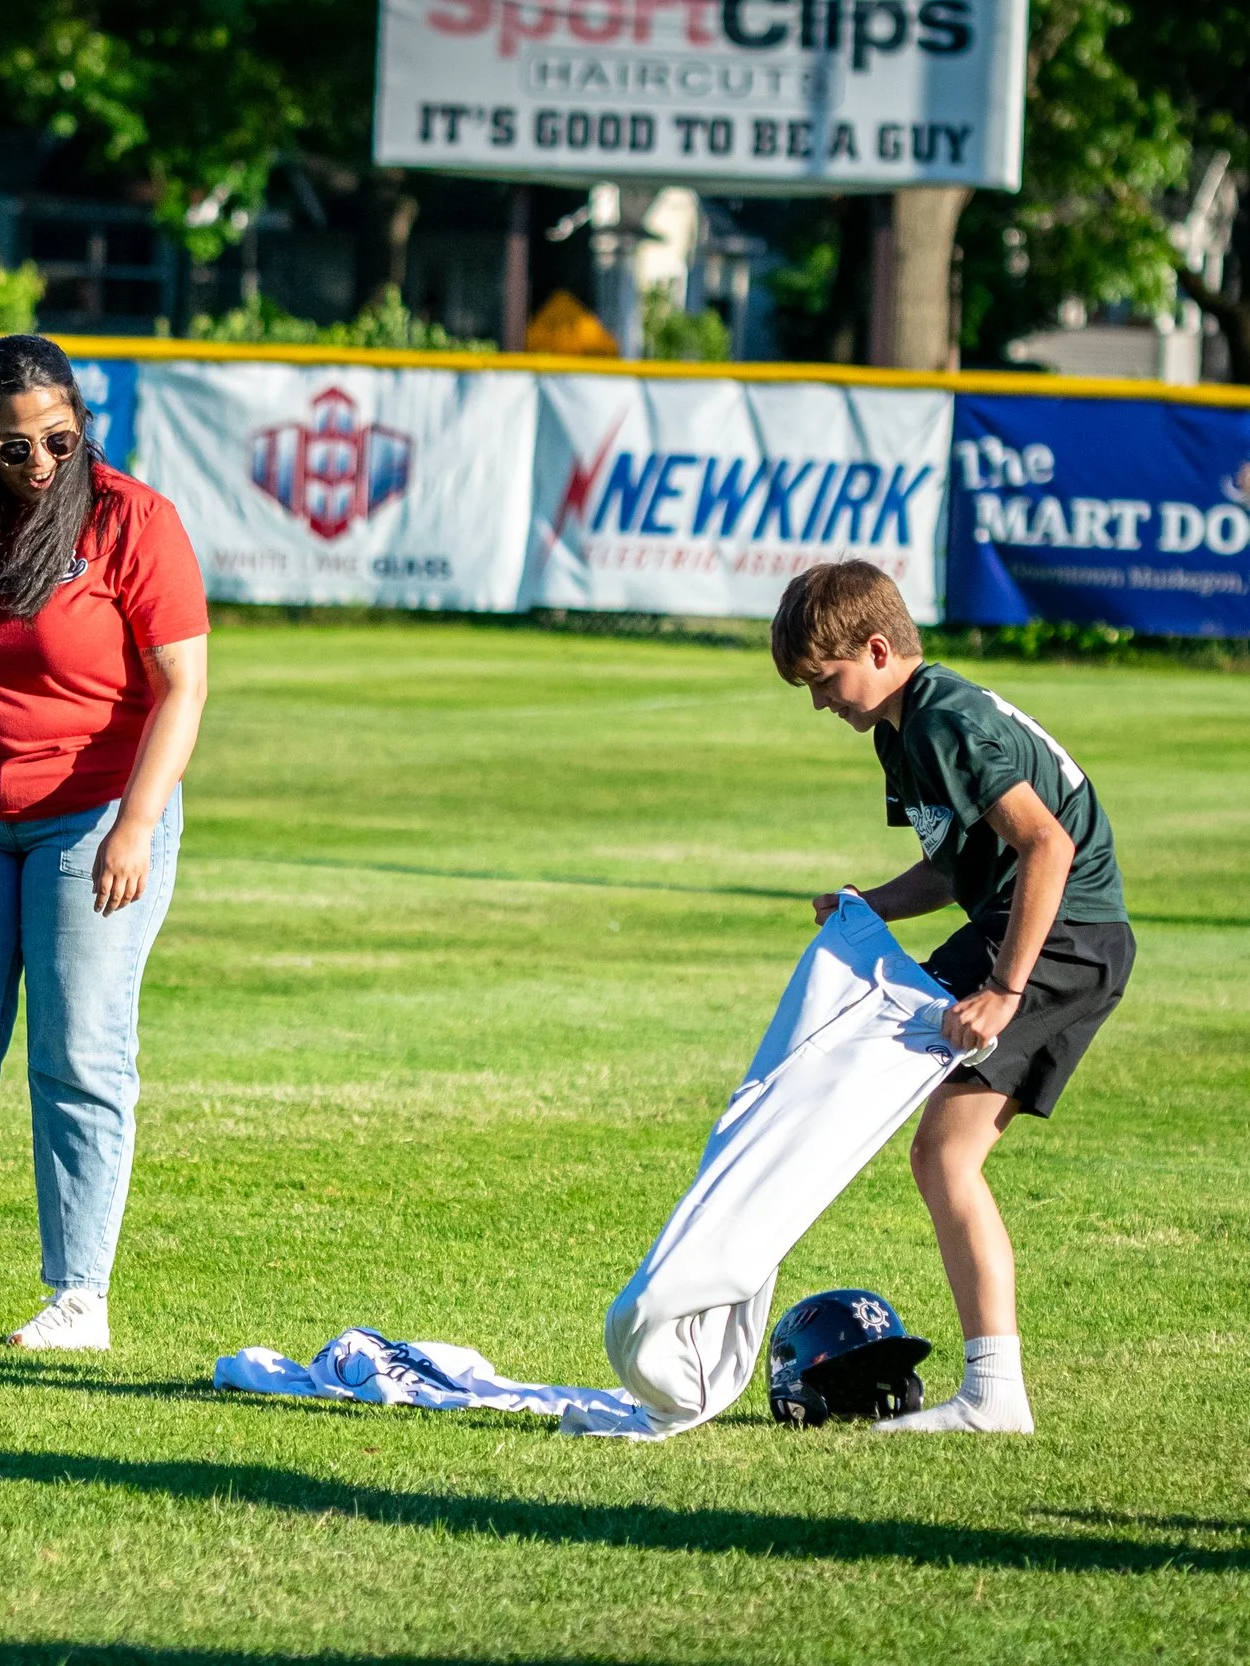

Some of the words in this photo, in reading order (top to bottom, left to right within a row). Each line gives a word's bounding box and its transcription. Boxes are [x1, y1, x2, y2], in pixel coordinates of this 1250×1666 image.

[419, 104, 515, 147] IT'S
[534, 109, 656, 152] GOOD
[675, 116, 732, 155] TO
[753, 119, 814, 158] BE
[829, 123, 858, 161] A
[877, 125, 972, 164] GUY
[956, 435, 1055, 489] The
[592, 451, 934, 546] NEWKIRK
[974, 494, 1151, 550] MART
